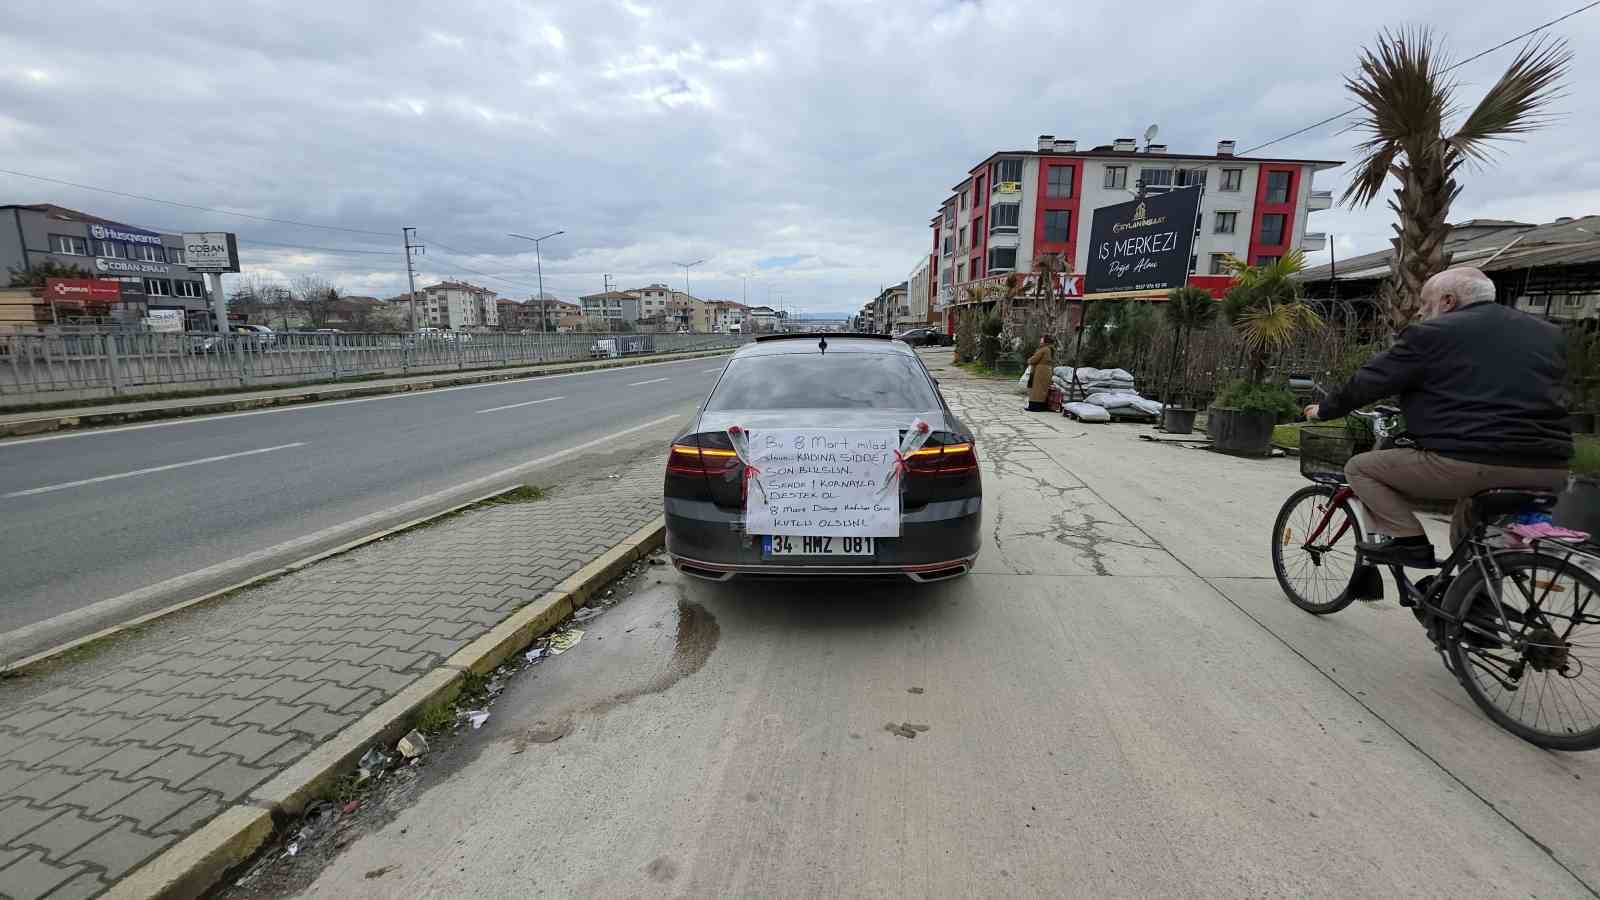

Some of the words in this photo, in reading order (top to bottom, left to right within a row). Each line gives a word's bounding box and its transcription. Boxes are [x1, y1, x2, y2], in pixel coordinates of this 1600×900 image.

[104, 227, 161, 245] Husqvarna
[792, 435, 805, 450] 8
[811, 435, 848, 449] Mart
[767, 467, 794, 479] SON
[773, 536, 793, 553] 34
[803, 536, 833, 553] HMZ
[843, 536, 872, 553] 081
